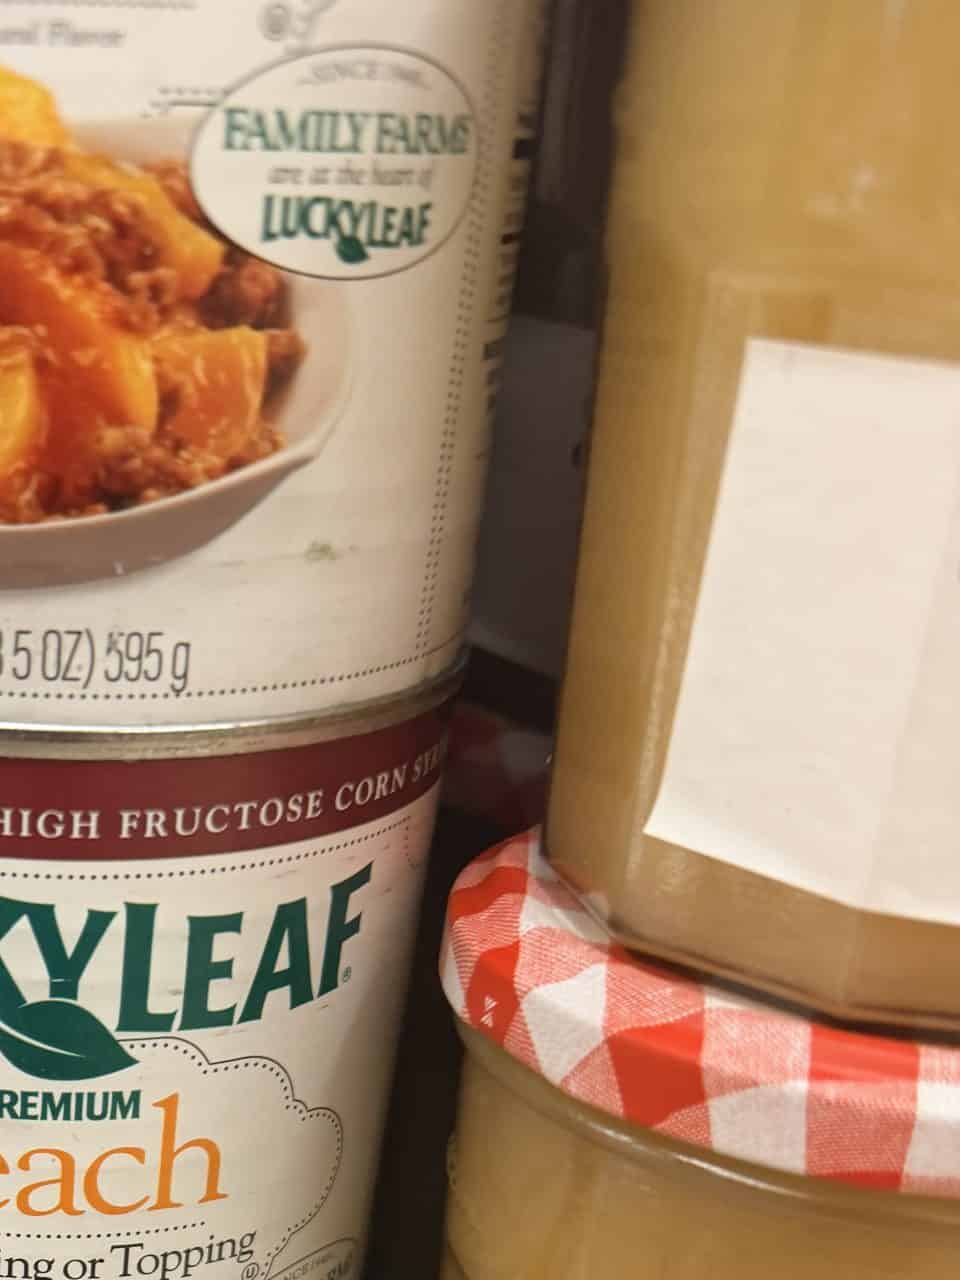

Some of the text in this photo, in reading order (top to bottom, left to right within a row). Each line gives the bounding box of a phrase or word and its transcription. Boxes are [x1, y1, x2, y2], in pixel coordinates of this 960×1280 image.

[222, 106, 368, 154] FAMILY
[12, 628, 33, 681] 5
[41, 628, 95, 690] OZ)
[104, 630, 165, 683] 595
[119, 788, 324, 840] FRUCTOSE
[334, 763, 409, 812] CORN
[62, 1252, 105, 1280] or
